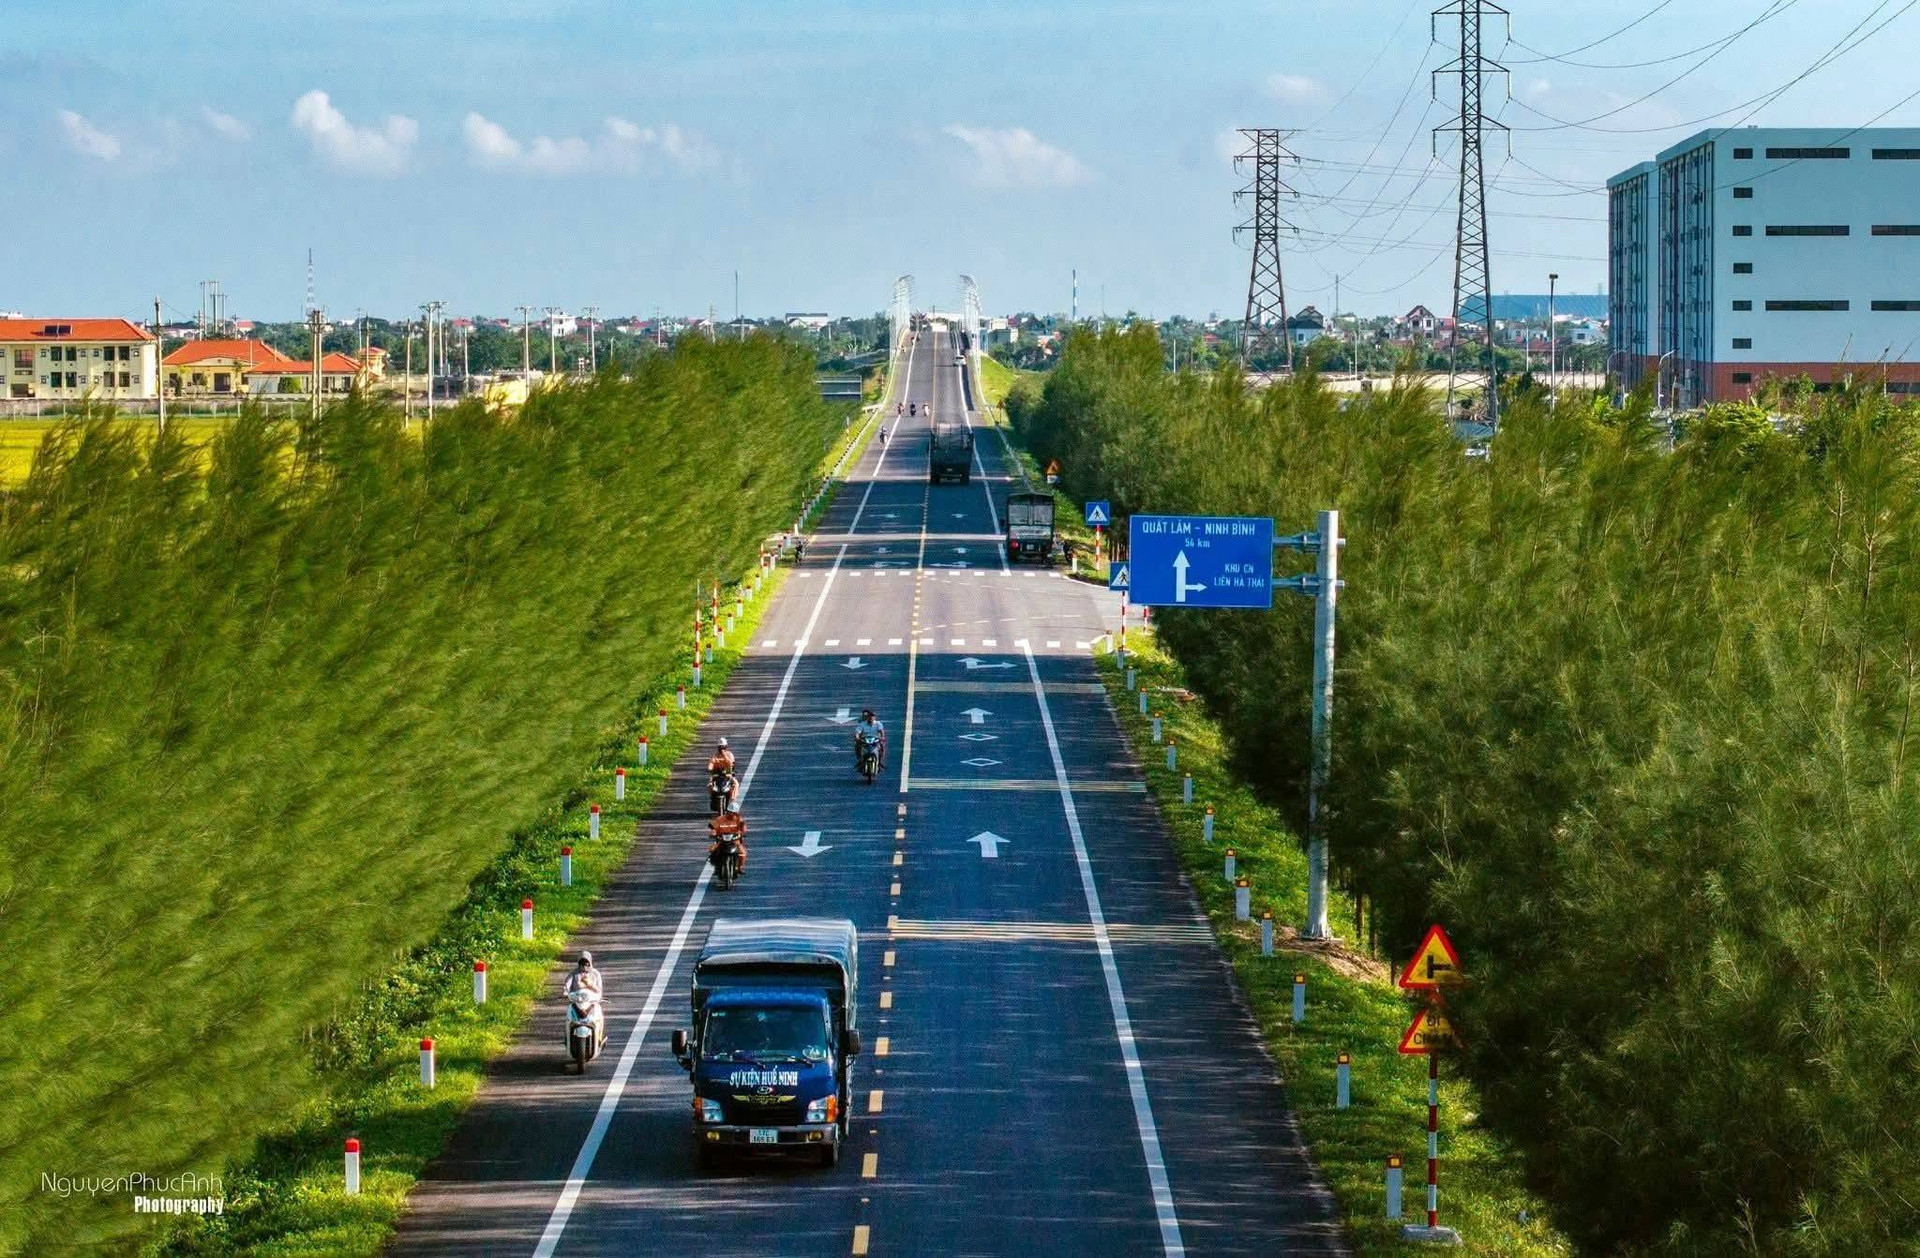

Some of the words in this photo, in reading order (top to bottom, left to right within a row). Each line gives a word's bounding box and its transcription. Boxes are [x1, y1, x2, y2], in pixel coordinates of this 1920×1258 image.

[1205, 522, 1229, 535] NINH
[1232, 520, 1255, 535] BÌNH
[1197, 538, 1211, 548] km
[1243, 563, 1254, 573] CN
[778, 1071, 798, 1087] NINH
